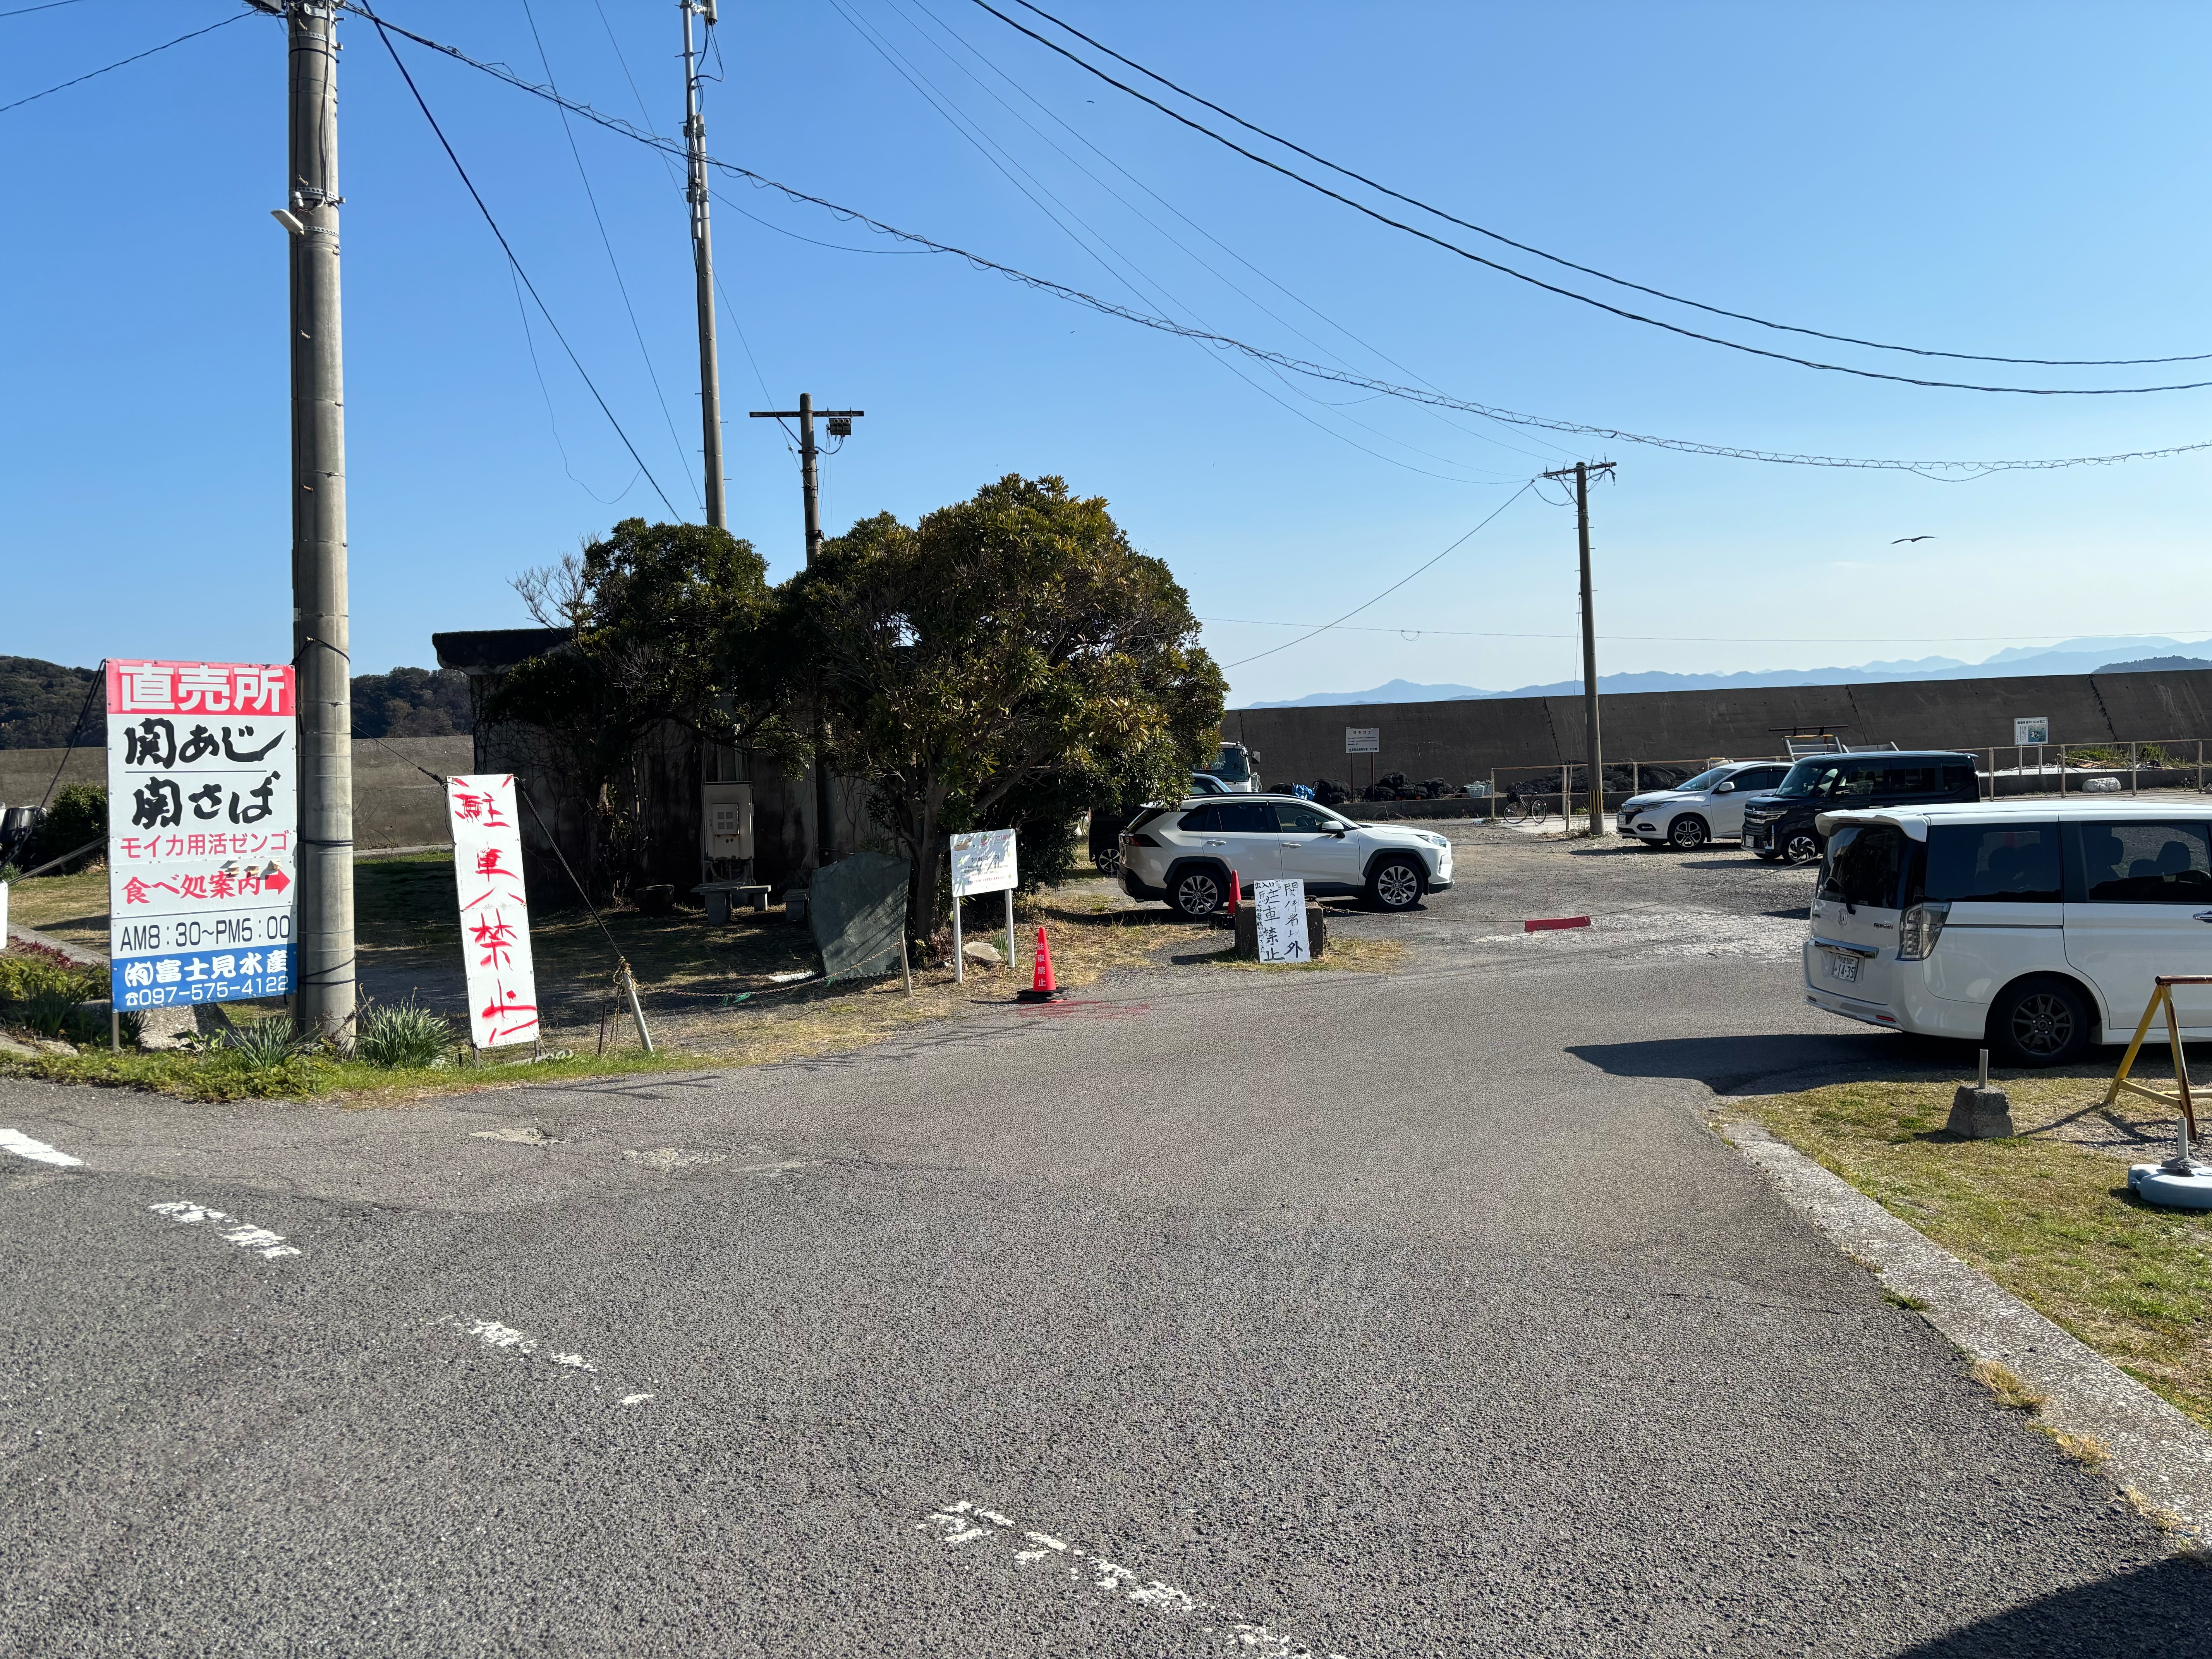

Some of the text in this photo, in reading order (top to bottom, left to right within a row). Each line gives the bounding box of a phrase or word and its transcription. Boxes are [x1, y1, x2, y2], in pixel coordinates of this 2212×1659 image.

[119, 663, 285, 712] 直売所
[124, 718, 287, 769] 関あじ
[131, 770, 281, 830] 関さば
[120, 830, 290, 859] モイカ用活ゼンゴ
[122, 870, 261, 905] 食べ処案内
[452, 790, 538, 1020] 駐車禁止
[1259, 888, 1285, 962] 駐車禁止
[1284, 881, 1303, 958] 関係者以外
[1037, 942, 1046, 987] 駐車禁止
